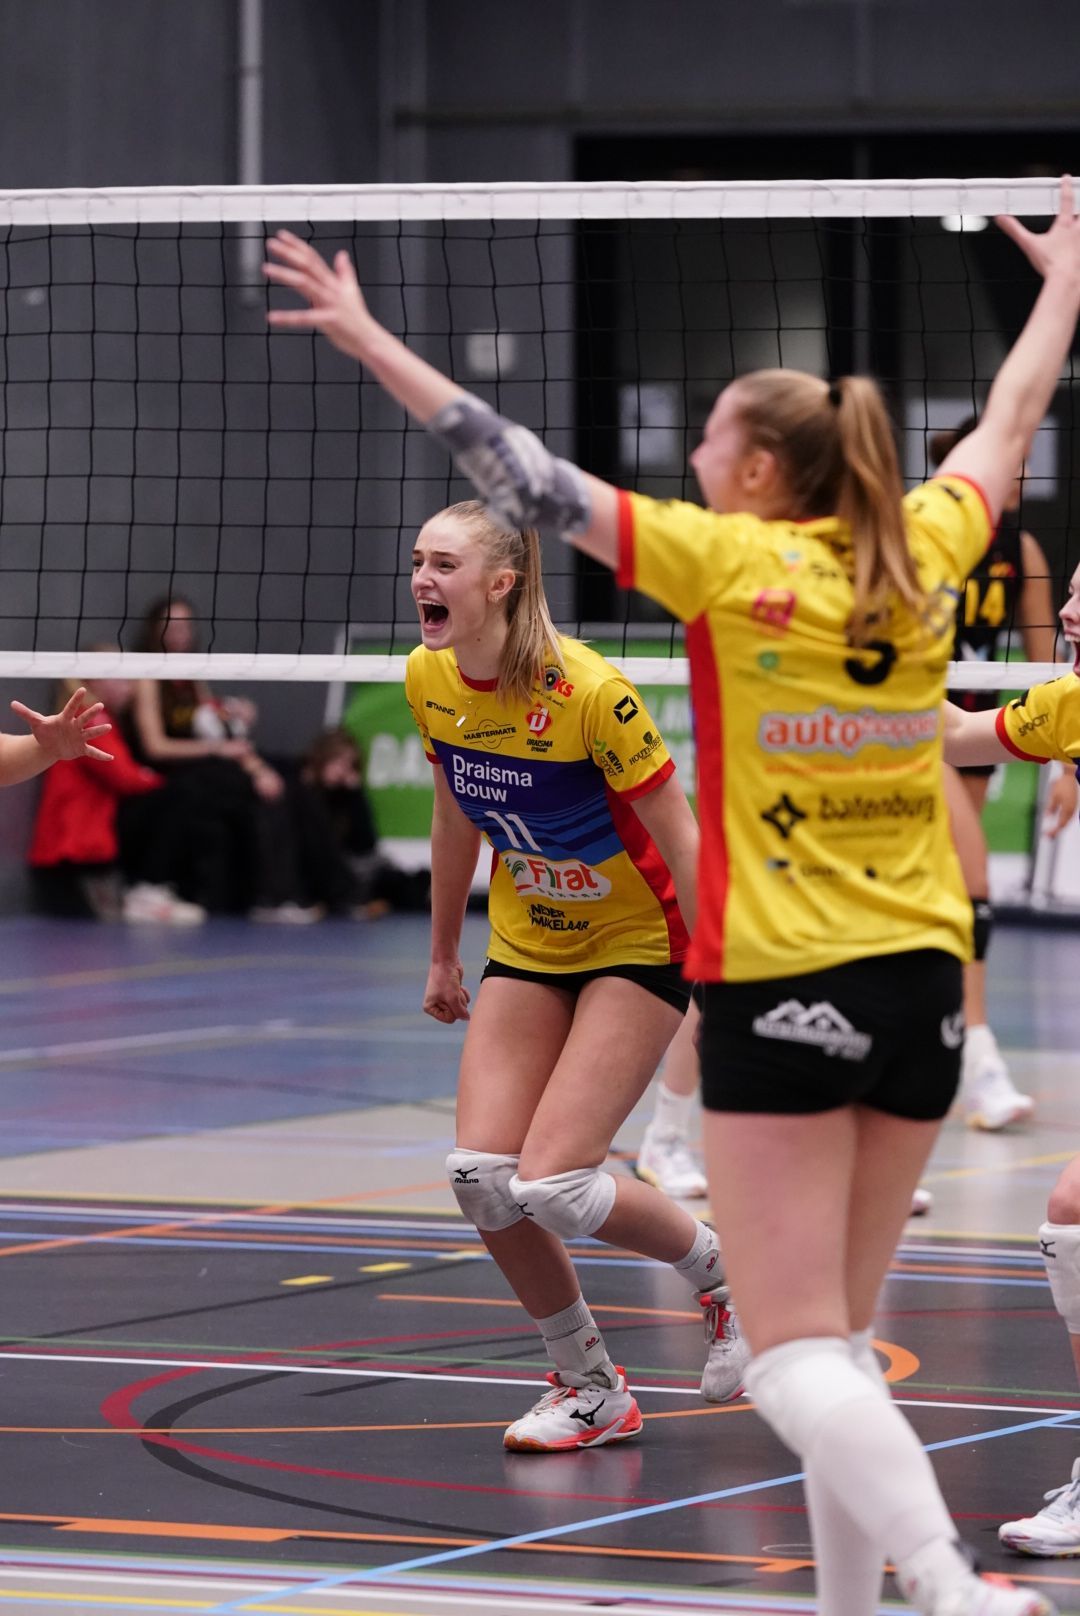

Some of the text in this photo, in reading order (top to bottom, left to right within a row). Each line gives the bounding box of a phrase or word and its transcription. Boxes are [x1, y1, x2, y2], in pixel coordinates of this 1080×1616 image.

[464, 727, 517, 740] MASTERMATE
[453, 754, 533, 787] Draisma
[605, 750, 625, 773] KIEVIT
[454, 774, 507, 803] Bouw
[484, 810, 543, 852] 11
